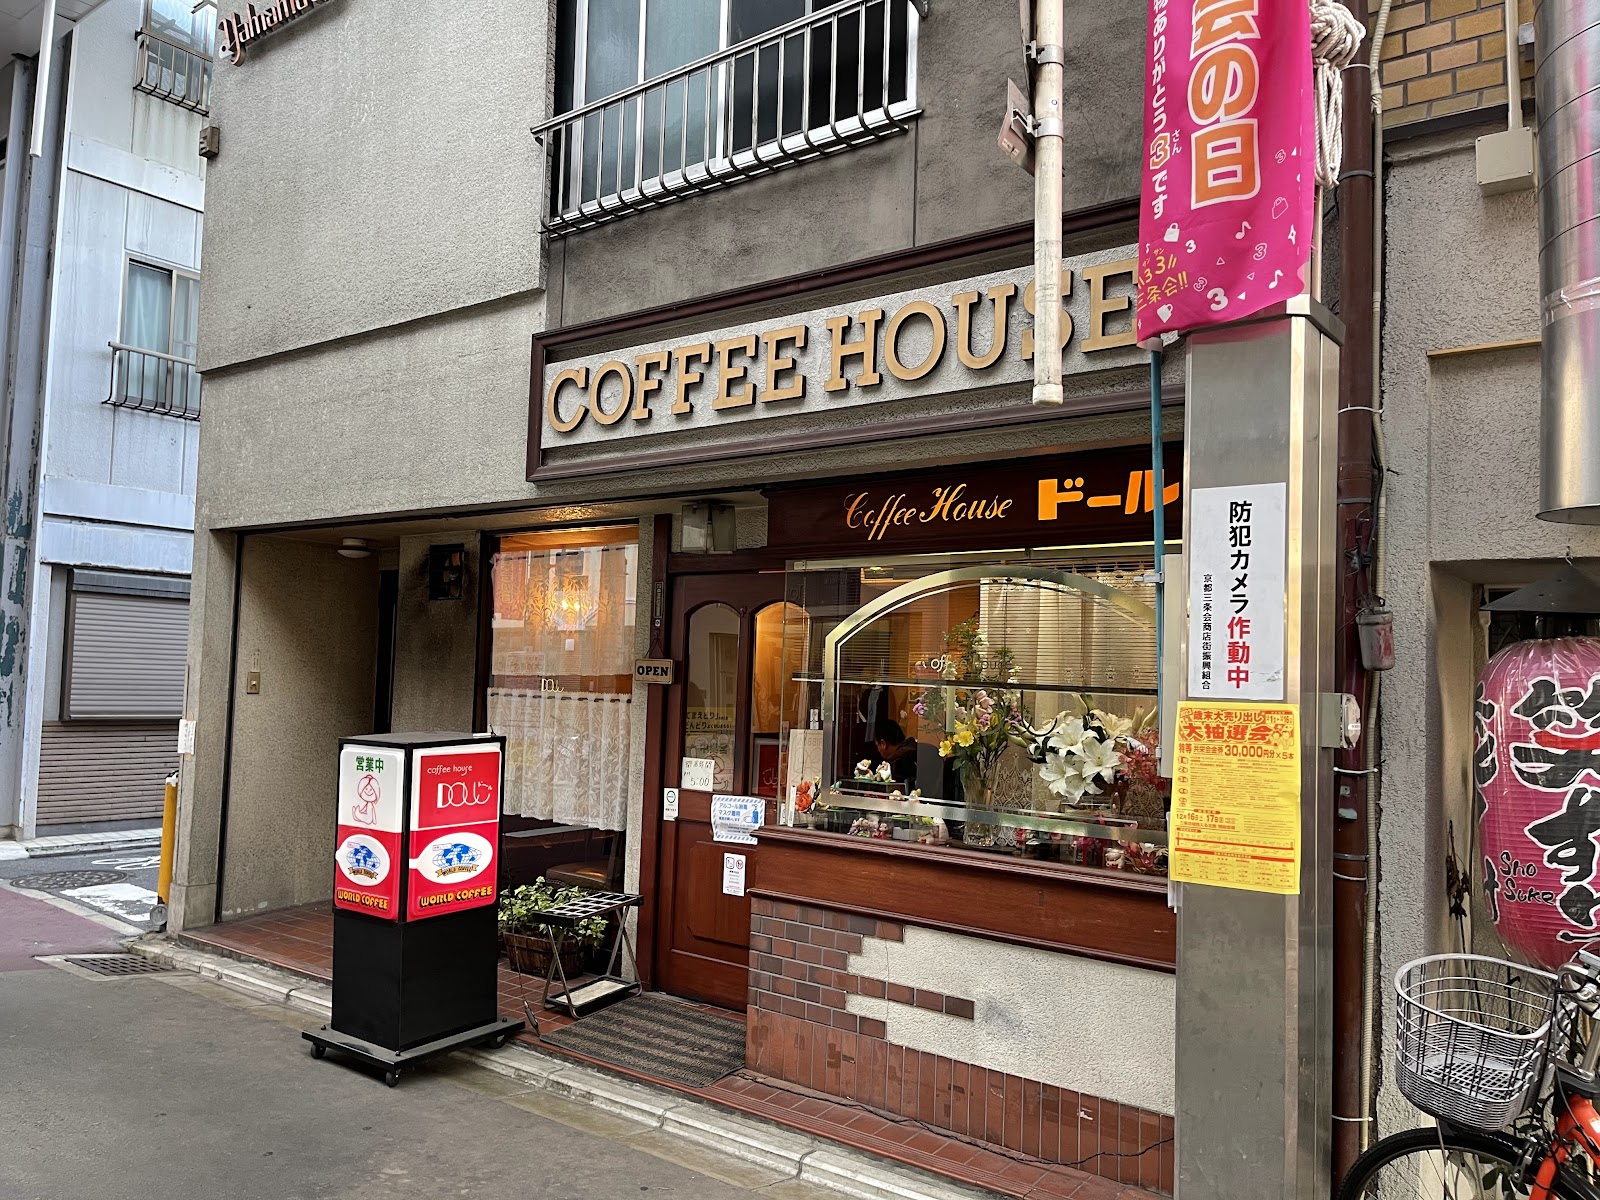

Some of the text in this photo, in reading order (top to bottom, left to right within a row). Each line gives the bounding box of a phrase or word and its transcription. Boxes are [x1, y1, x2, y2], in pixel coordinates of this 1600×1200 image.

[546, 325, 807, 433] COFFEE
[1037, 469, 1179, 521] ドール
[844, 483, 1014, 541] Coffee House
[1226, 500, 1252, 690] 防犯カメラ作動中
[1201, 573, 1213, 691] 京都三条会商店街振興組合
[636, 664, 670, 677] OPEN
[1193, 710, 1264, 724] 歳末大売り出し
[1183, 723, 1273, 742] 大抽選会
[355, 755, 384, 773] 営業中
[426, 764, 452, 776] coffee
[337, 889, 389, 910] WORLD COFFEE
[420, 885, 493, 908] WORLD COFFEE
[1502, 877, 1557, 905] Suke
